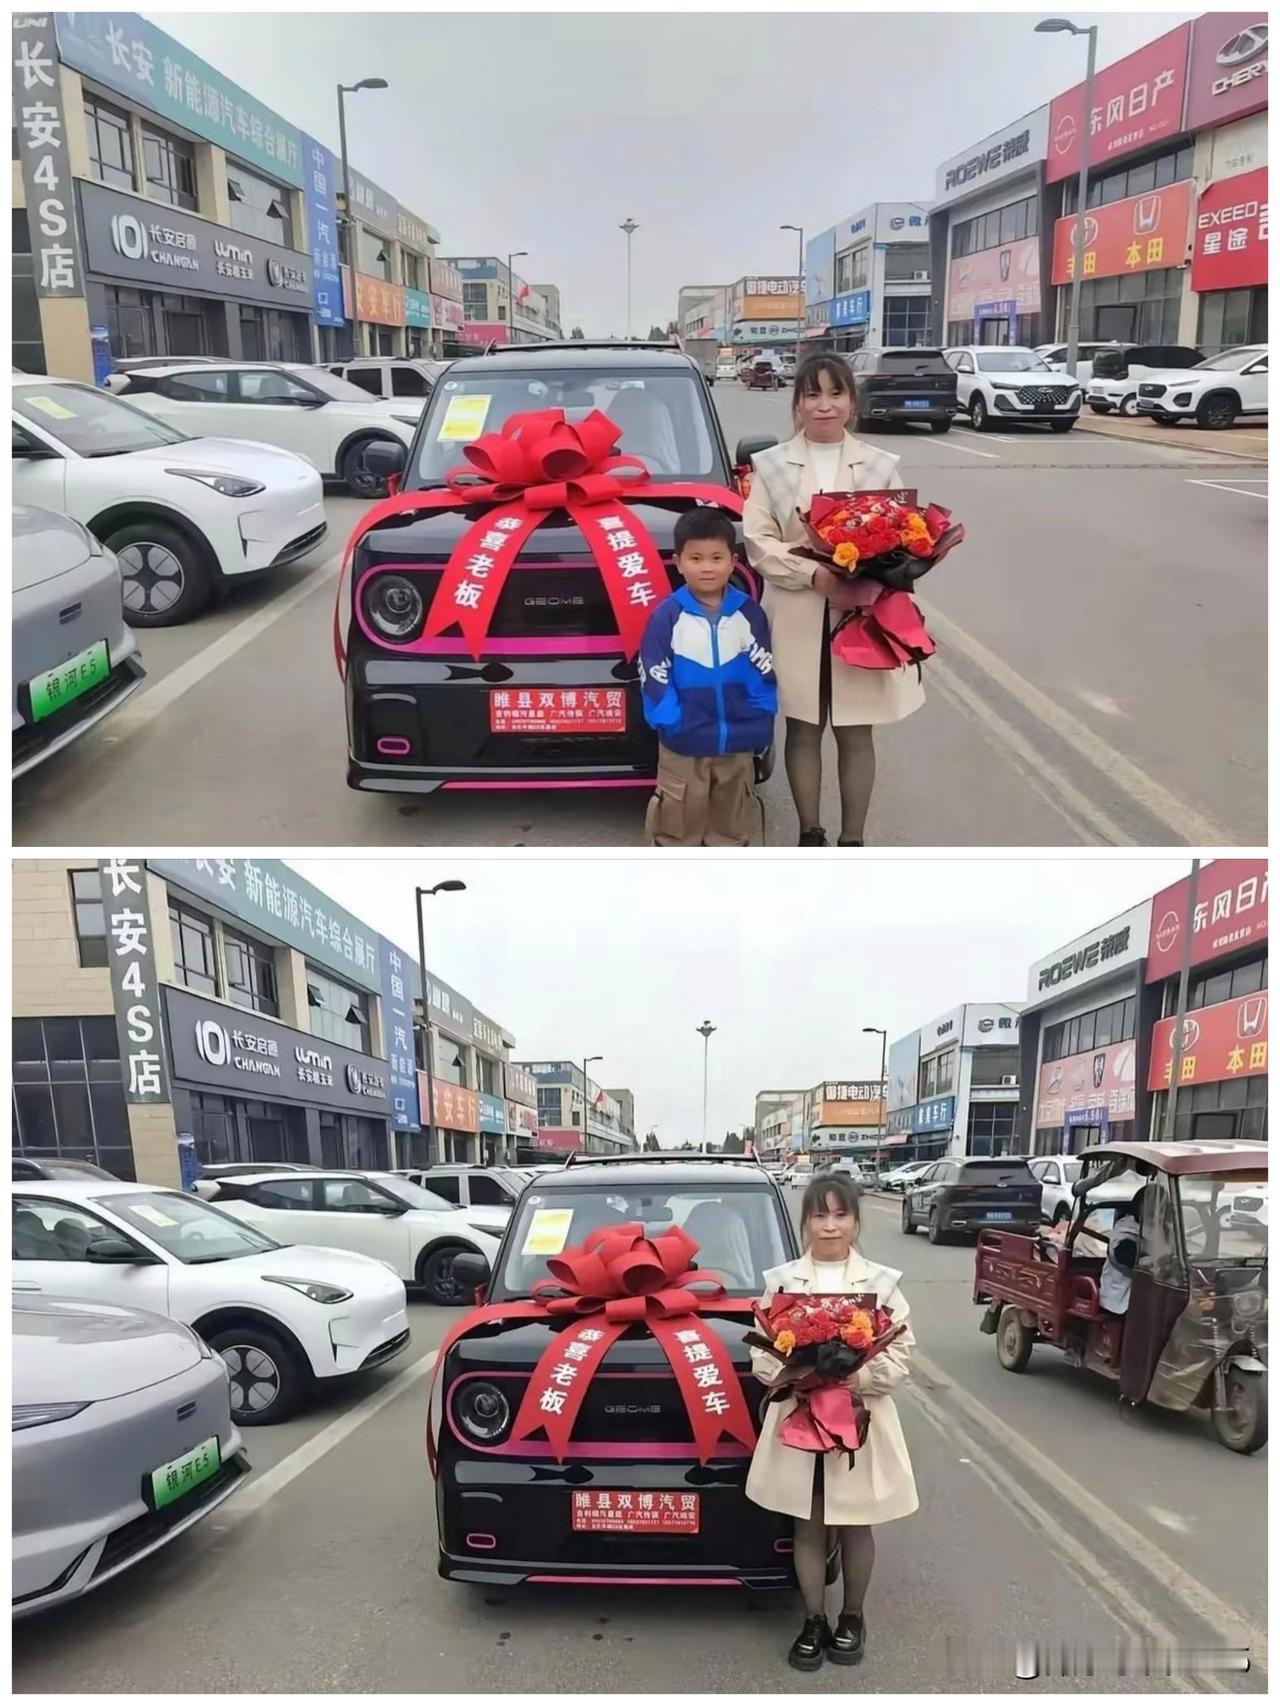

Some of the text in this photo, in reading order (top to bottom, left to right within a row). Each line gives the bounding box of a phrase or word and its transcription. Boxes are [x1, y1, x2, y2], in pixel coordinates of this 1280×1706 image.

[105, 19, 155, 87] 长安
[1089, 68, 1175, 137] 东风日产
[15, 40, 76, 290] 长安4S店
[945, 143, 1001, 191] ROEWE
[1198, 201, 1258, 229] EXEED
[1203, 227, 1249, 255] 星途
[151, 250, 199, 271] CHANGAN
[1125, 237, 1163, 269] 本田
[453, 516, 524, 609] 恭喜老板
[595, 515, 656, 607] 喜提爱车
[493, 691, 622, 708] 睢县双博汽贸
[244, 859, 376, 975] 新能源汽车综合展厅
[103, 859, 161, 1095] 长安4S店
[1038, 940, 1100, 991] ROEWE
[389, 950, 408, 1051] 中国一汽
[234, 1056, 280, 1078] CHANGAN
[1226, 1041, 1268, 1074] 本田
[539, 1328, 605, 1415] 恭喜老板
[673, 1328, 731, 1415] 喜提爱车
[575, 1492, 696, 1511] 睢县双博汽贸
